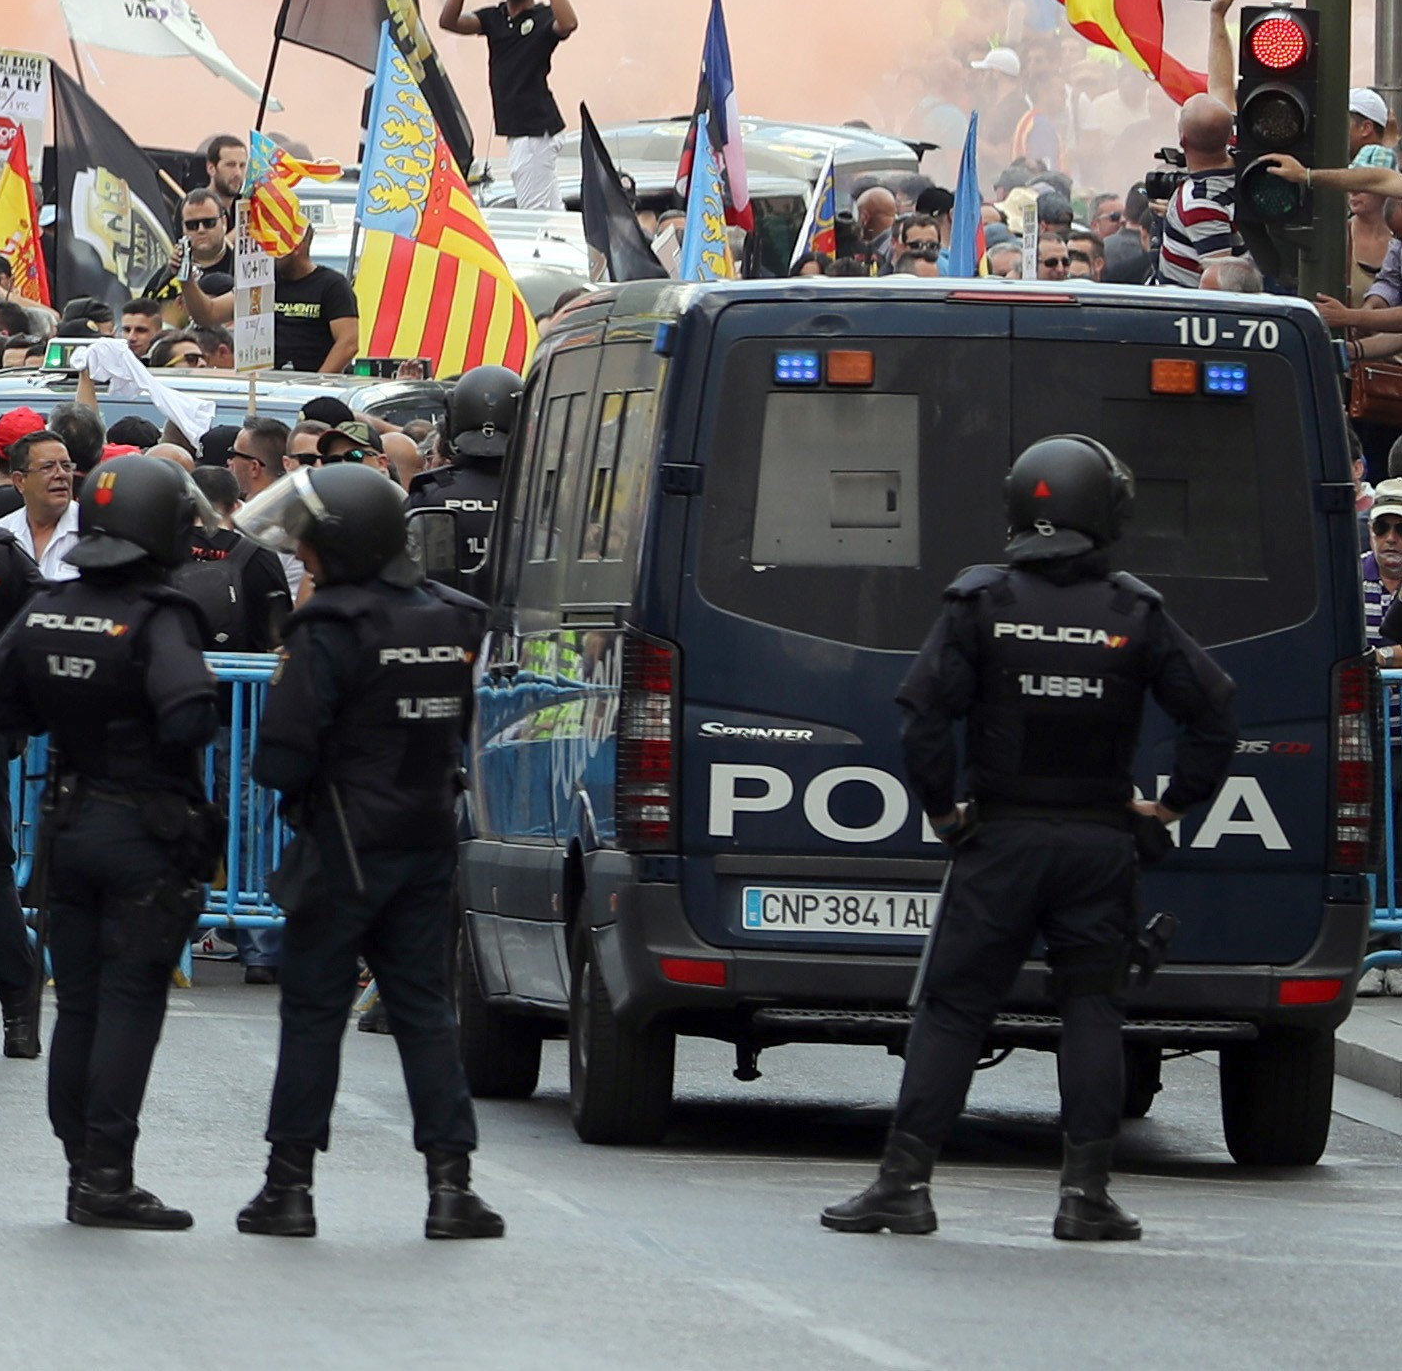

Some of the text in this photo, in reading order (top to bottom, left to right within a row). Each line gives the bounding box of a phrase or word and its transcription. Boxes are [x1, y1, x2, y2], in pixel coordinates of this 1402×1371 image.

[13, 56, 42, 70] EXIGE
[17, 77, 42, 93] LEY
[1173, 316, 1280, 350] 1U-70
[26, 613, 115, 634] POLICIA
[993, 621, 1112, 646] POLICIA
[378, 646, 466, 666] POLICIA
[698, 721, 814, 742] SPRINTER
